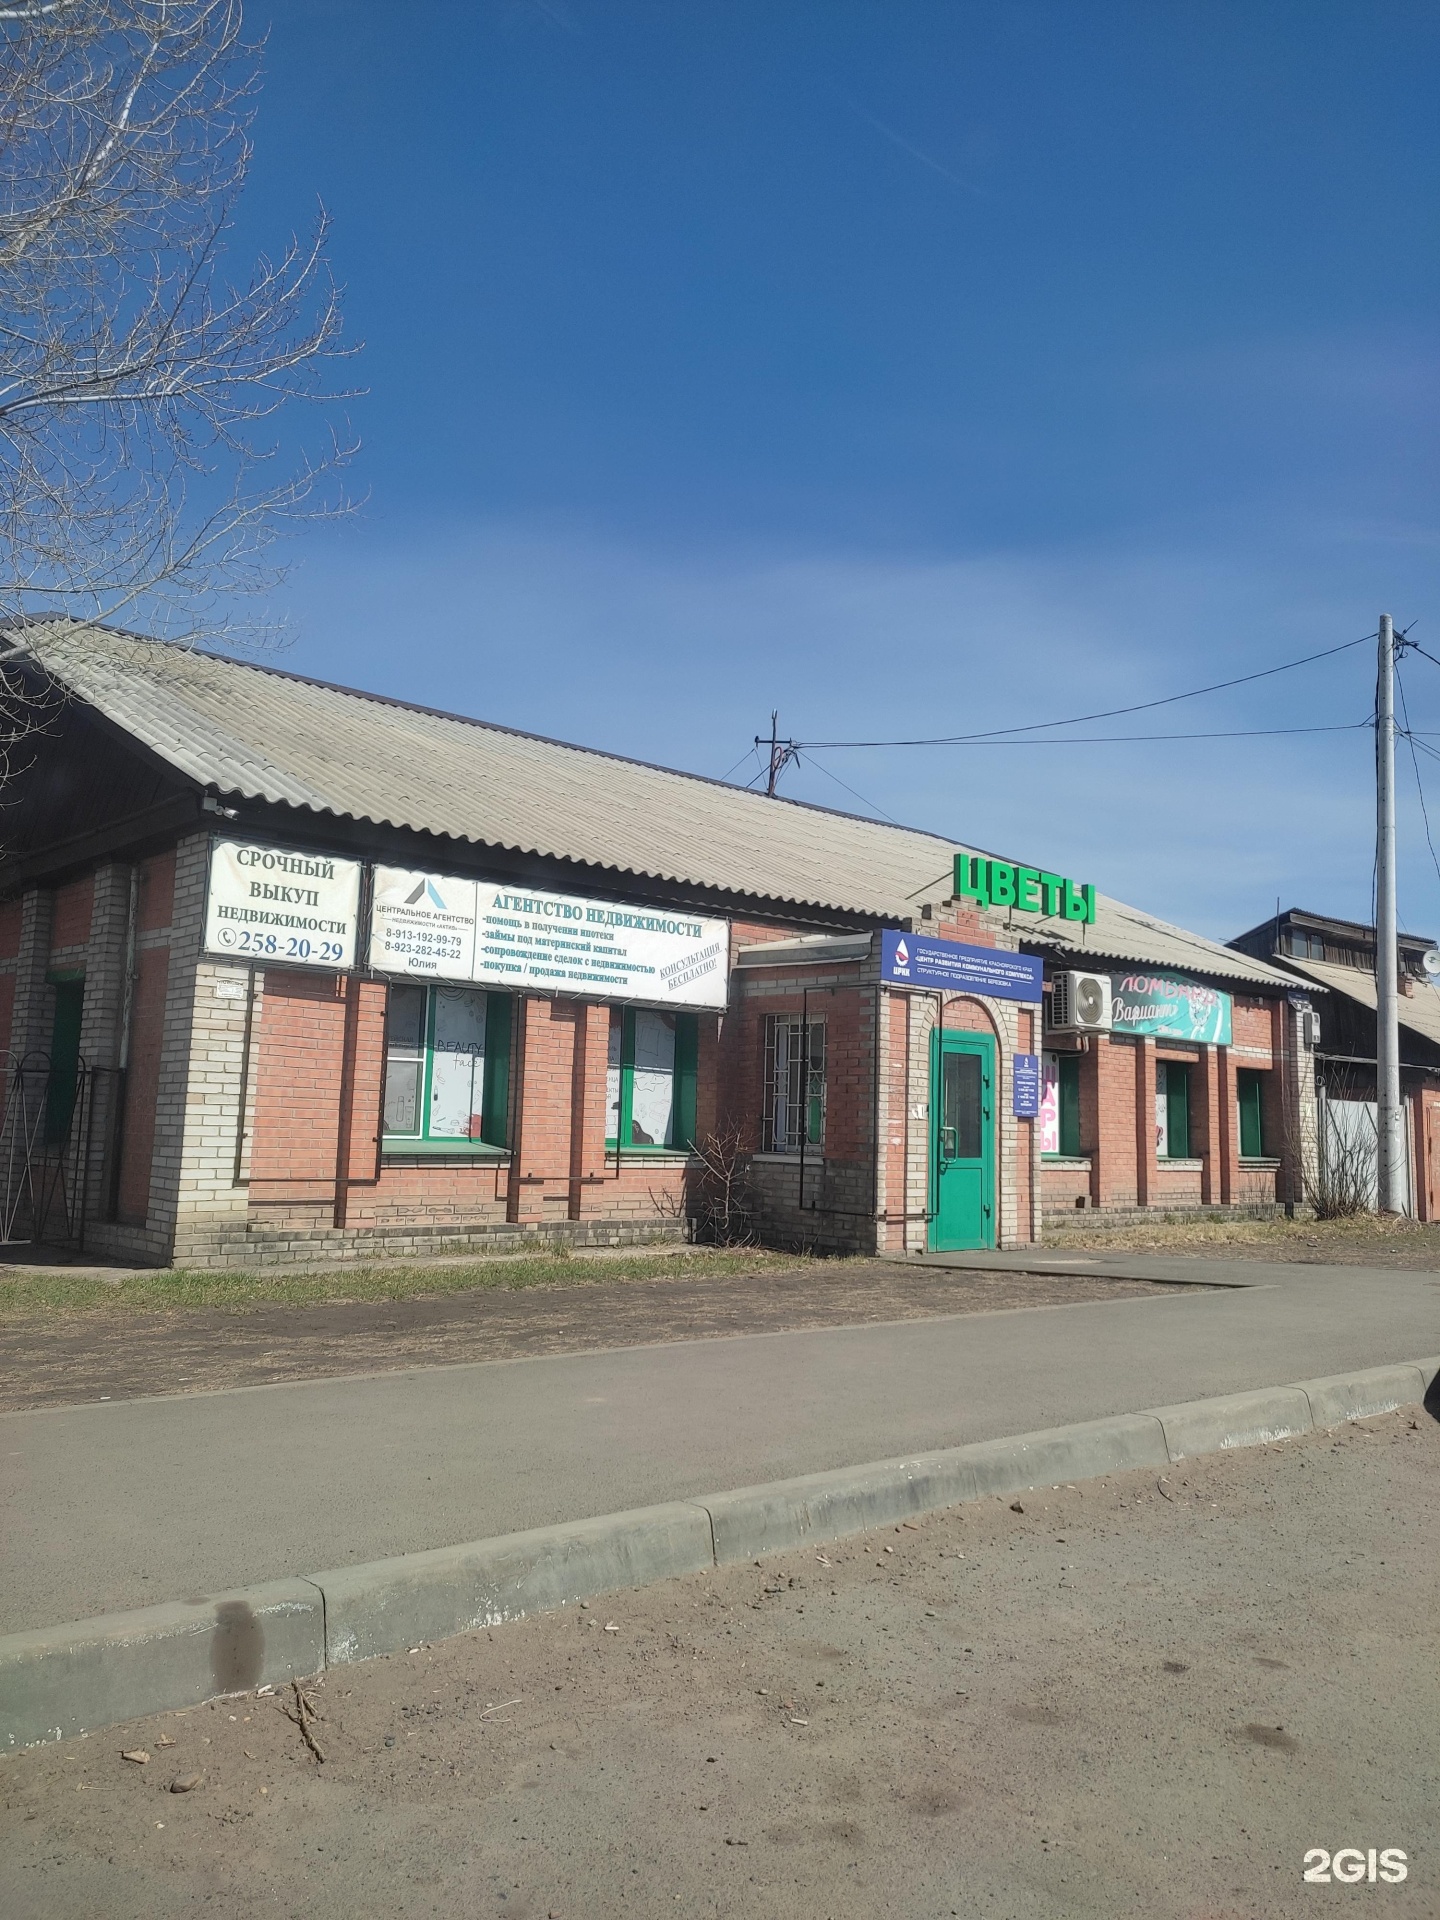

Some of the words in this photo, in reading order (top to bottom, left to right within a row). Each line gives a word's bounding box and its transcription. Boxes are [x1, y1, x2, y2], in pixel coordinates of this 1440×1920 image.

[237, 849, 335, 880] СРОЧНЫЙ
[249, 881, 319, 907] ВЫКУП
[954, 853, 1096, 925] ЦВЕТЫ
[217, 905, 347, 934] НЕДВИЖИМОСТИ
[376, 905, 431, 919] ЦЕНТРАЛЬНОЕ
[433, 913, 474, 925] АГЕНТСТВО
[492, 894, 583, 920] АГЕНТСТВО
[586, 907, 703, 938] НЕДВИЖИМОСТИ
[386, 928, 462, 946] 8-913-192-99-79
[482, 916, 522, 928] -помощь
[524, 921, 530, 929] в
[532, 922, 578, 936] получении
[580, 928, 614, 941] ипотеки
[238, 931, 343, 961] 258-20-29
[384, 941, 461, 959] 8-923-282-45-22
[482, 930, 515, 943] -займы
[517, 935, 533, 945] под
[535, 937, 592, 952] материнский
[592, 945, 627, 956] капитал
[408, 957, 437, 970] Юлия
[480, 960, 522, 973] -покупка
[529, 965, 566, 978] продажа
[568, 970, 628, 985] недвижимости
[481, 945, 553, 961] -сопровождение
[554, 954, 583, 966] сделок
[591, 959, 655, 974] недвижимостью
[659, 942, 721, 979] КОНСУЛЬТАЦИЯ
[667, 958, 718, 990] БЕСПЛАТНО!
[437, 1040, 483, 1055] BEAUTY
